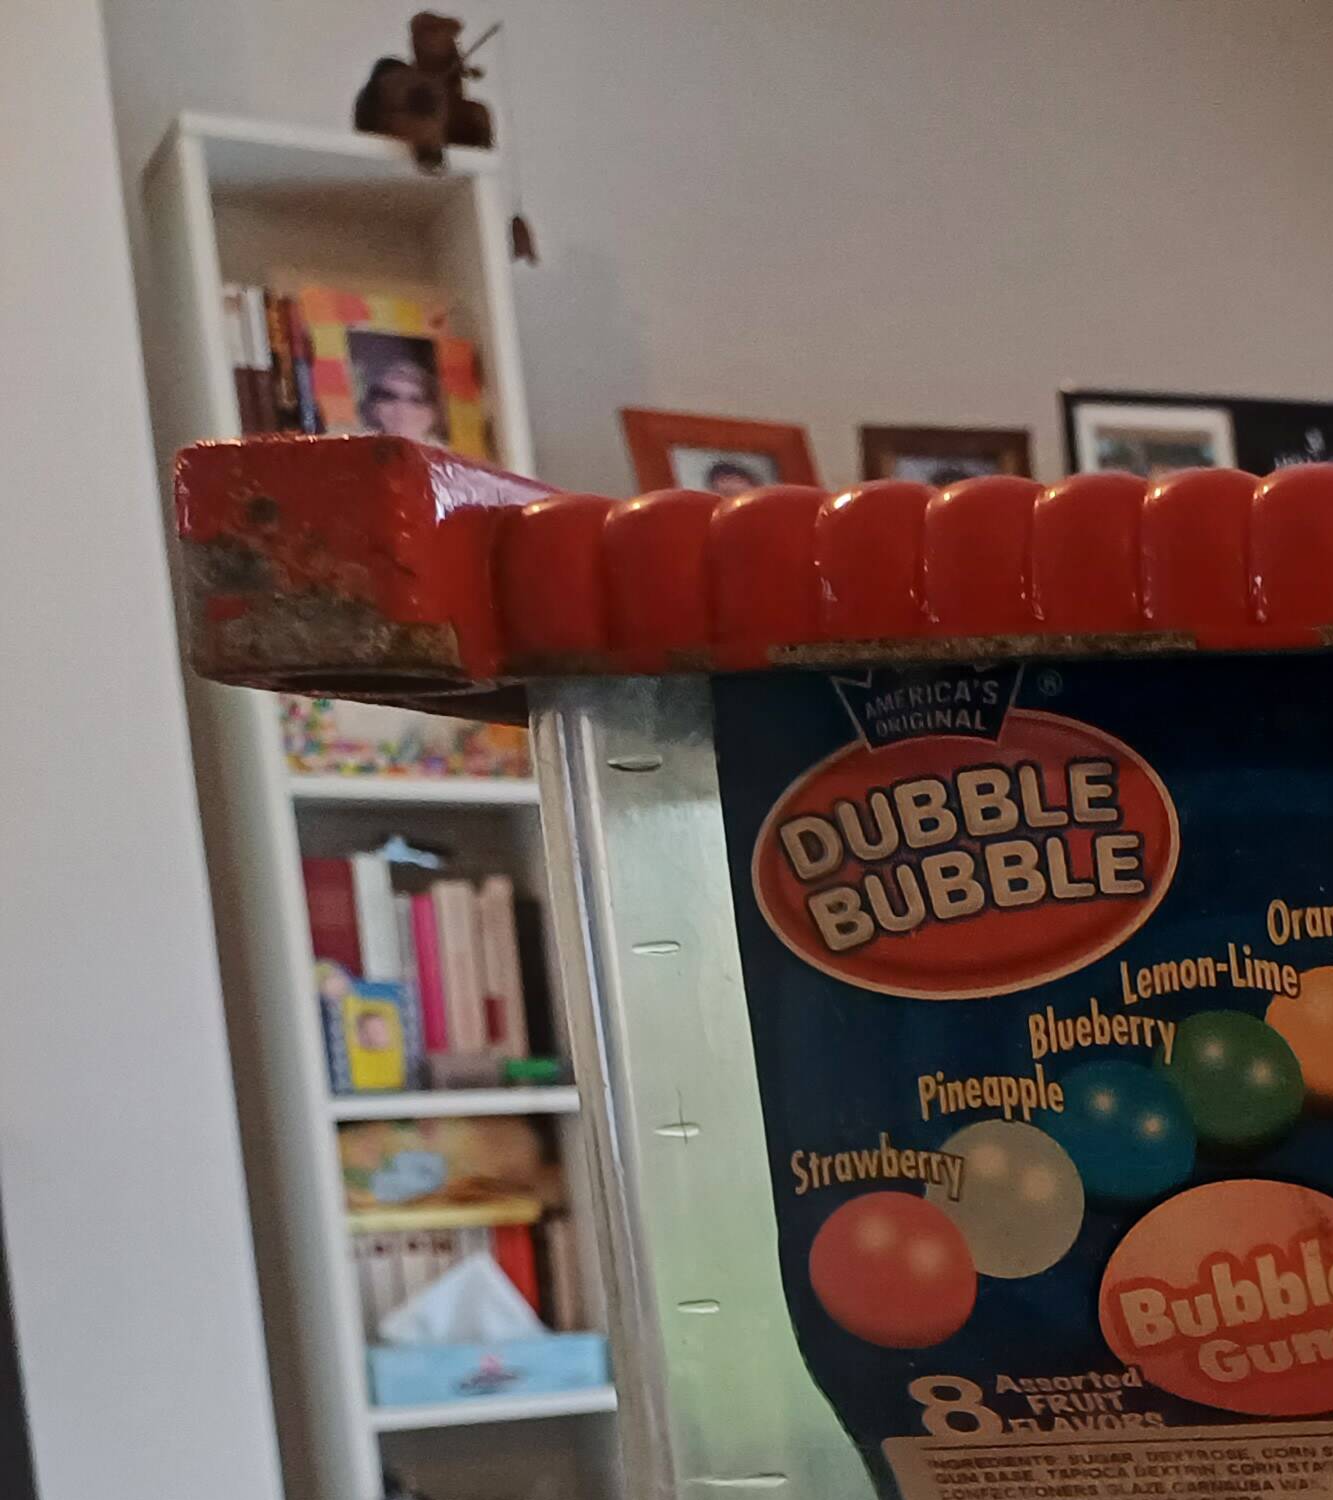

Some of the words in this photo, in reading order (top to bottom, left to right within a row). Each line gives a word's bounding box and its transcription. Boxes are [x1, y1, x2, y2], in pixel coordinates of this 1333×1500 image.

[864, 680, 999, 720] AMERICA'S
[875, 708, 987, 738] ORIGINAL
[778, 760, 1118, 882] DUBBLE
[806, 834, 1145, 952] BUBBLE
[1121, 943, 1299, 1005] Lemon-Lime
[1029, 998, 1176, 1064] Blueberry
[918, 1064, 1064, 1121] Pineapple
[790, 1132, 965, 1201] Strawberry
[908, 1374, 1002, 1437] 8
[996, 1367, 1143, 1394] Assorted
[1008, 1411, 1165, 1435] FLAVORS
[1026, 1390, 1123, 1415] FRUIT
[1227, 1461, 1283, 1476] CORN
[1262, 1446, 1316, 1460] CORN
